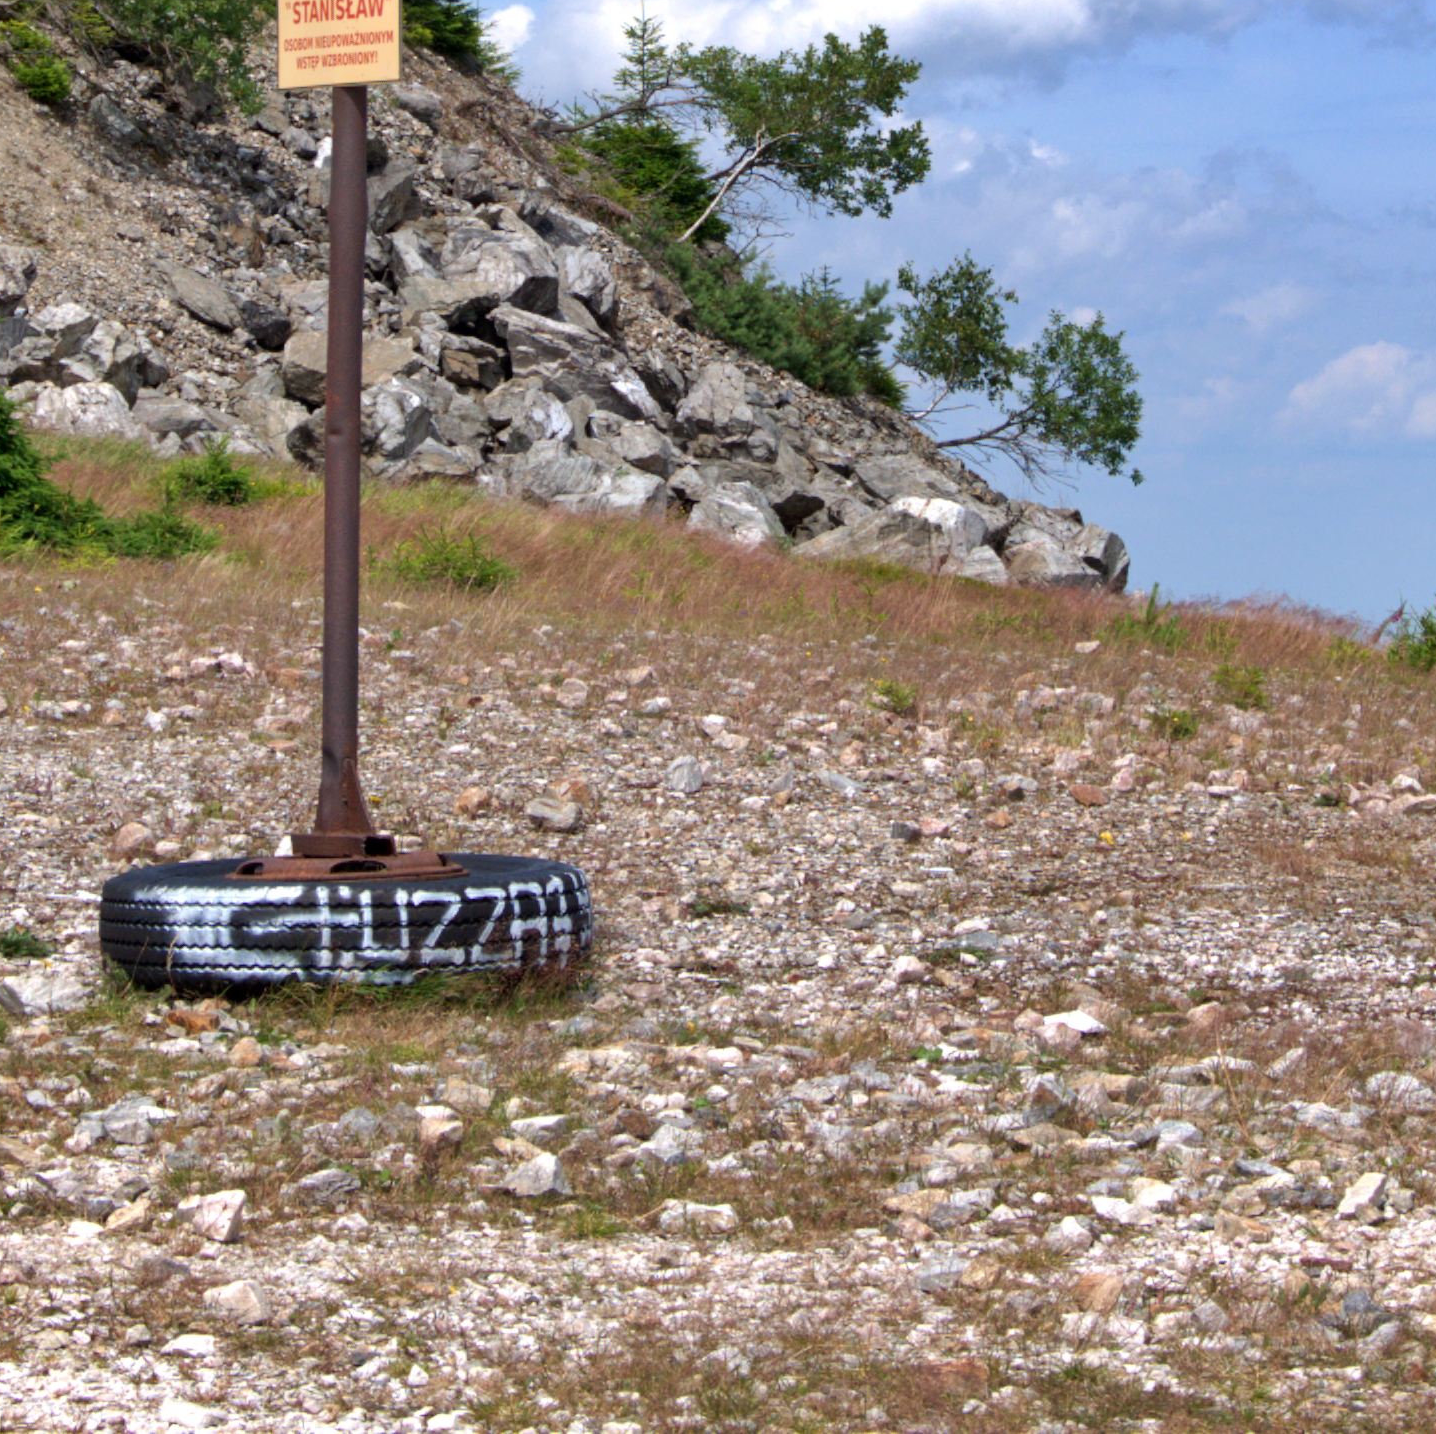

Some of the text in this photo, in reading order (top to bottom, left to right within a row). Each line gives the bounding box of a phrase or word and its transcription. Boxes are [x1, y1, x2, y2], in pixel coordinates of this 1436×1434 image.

[283, 37, 314, 52] OSOBOM
[296, 51, 379, 71] WSTĘP WZBRONIONY!
